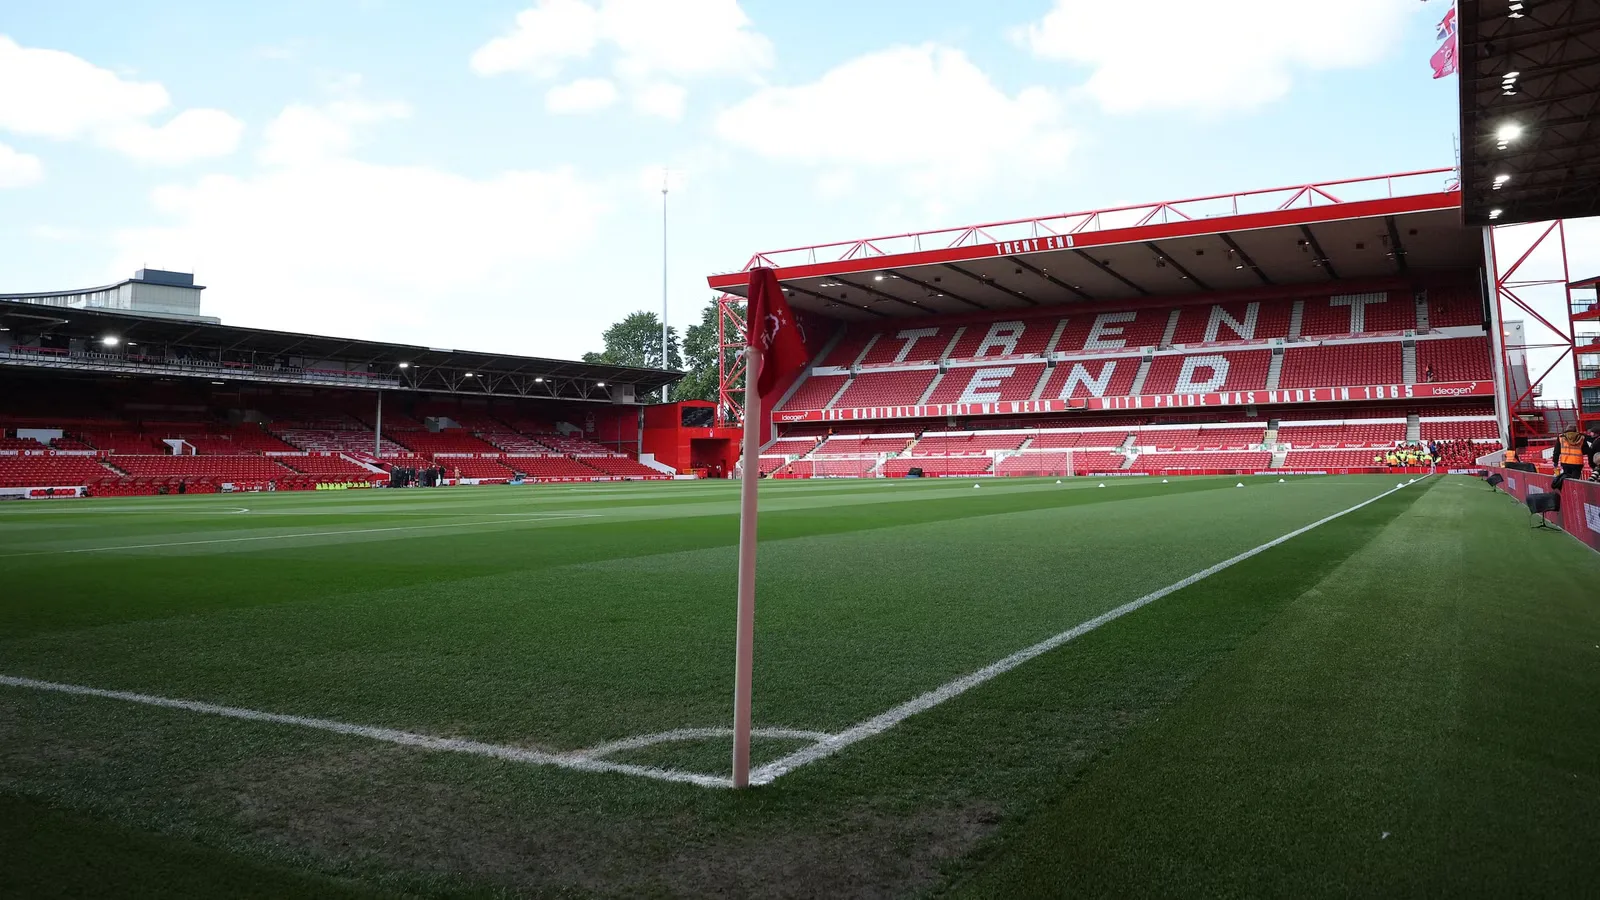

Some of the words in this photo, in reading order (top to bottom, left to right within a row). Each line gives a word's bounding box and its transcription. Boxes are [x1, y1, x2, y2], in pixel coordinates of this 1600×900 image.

[995, 239, 1039, 255] TRENT
[1046, 235, 1074, 249] END
[893, 291, 1387, 363] TRENT
[956, 355, 1230, 404] END
[1432, 385, 1473, 396] Ideagen
[821, 409, 843, 420] THE
[852, 405, 927, 419] GARIBALDI
[937, 403, 970, 416] THAT
[982, 402, 1000, 414] WE
[1011, 401, 1051, 413] WEAR
[1102, 396, 1142, 409] WITH
[1154, 394, 1206, 407] PRIDE
[1219, 392, 1254, 405] WAS
[1269, 389, 1316, 403] MADE
[1331, 386, 1349, 400] IN
[1364, 384, 1413, 399] 1865
